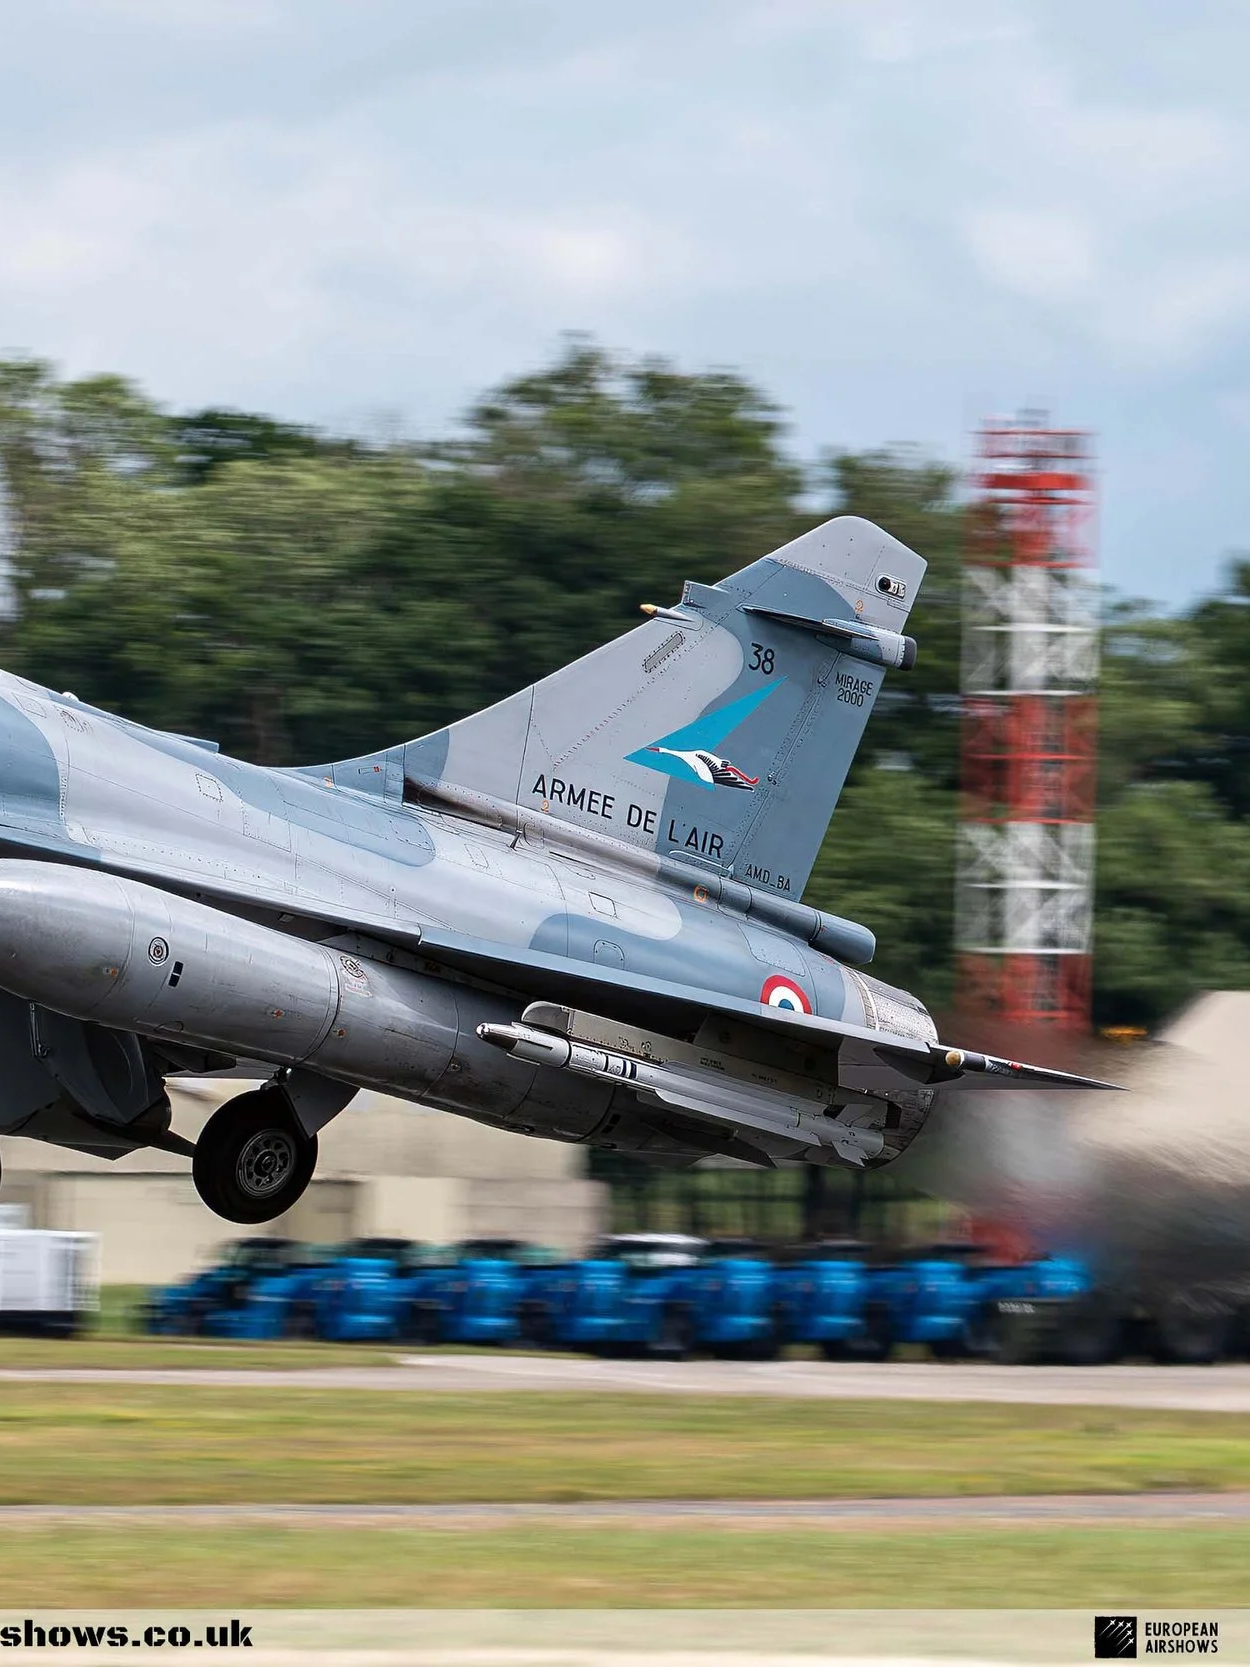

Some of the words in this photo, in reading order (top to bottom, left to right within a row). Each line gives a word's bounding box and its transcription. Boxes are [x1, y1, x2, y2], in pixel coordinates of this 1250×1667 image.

[748, 642, 776, 676] 38
[835, 671, 874, 697] MIRAGE
[836, 688, 865, 708] 2000
[532, 774, 616, 820] ARMEE
[627, 804, 658, 835] DE
[668, 819, 725, 859] L'AIR
